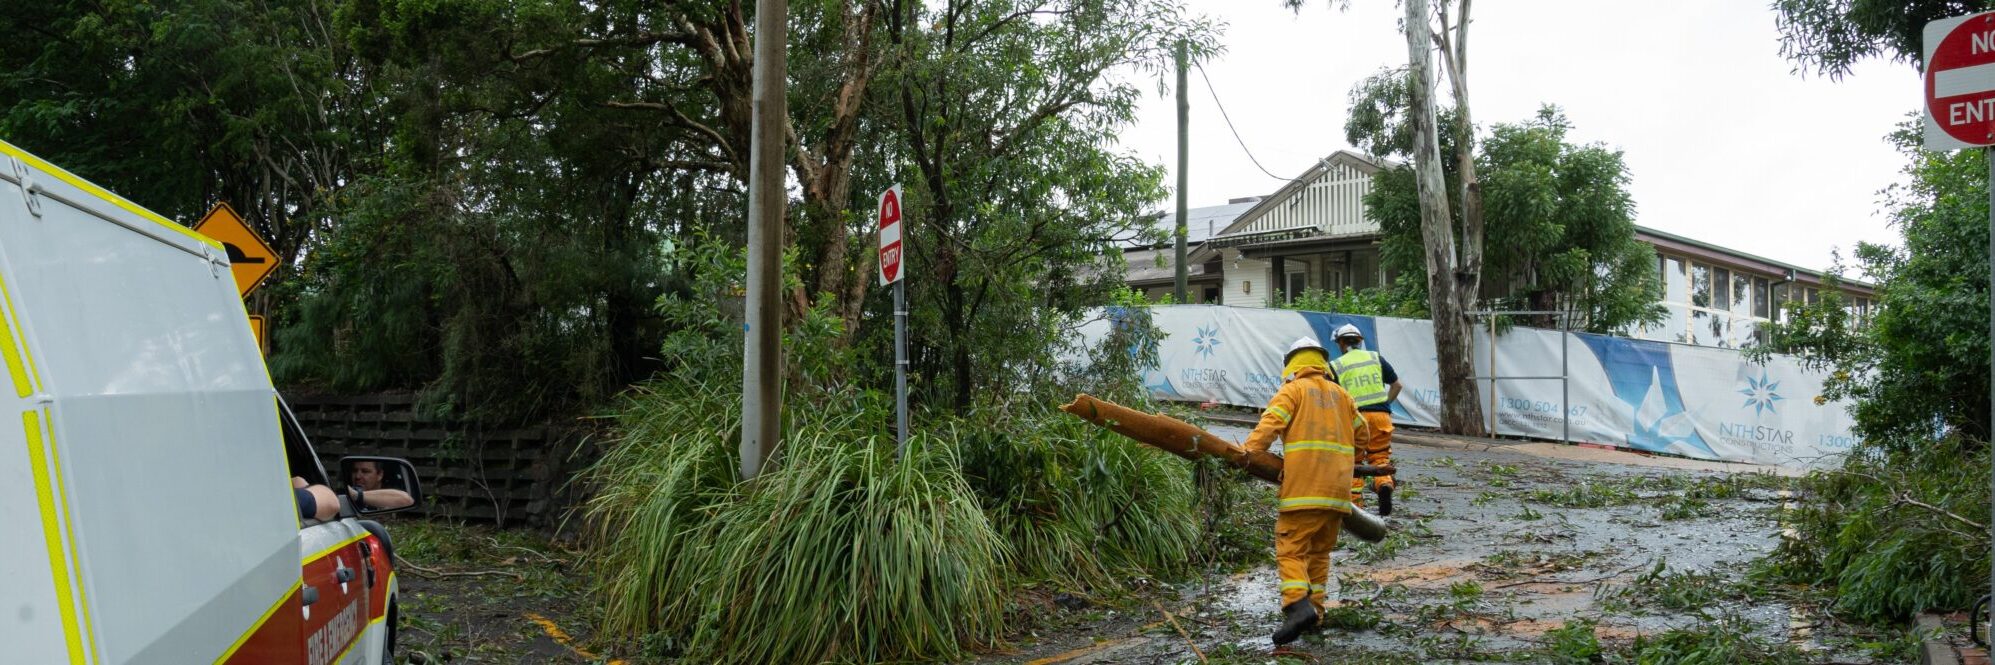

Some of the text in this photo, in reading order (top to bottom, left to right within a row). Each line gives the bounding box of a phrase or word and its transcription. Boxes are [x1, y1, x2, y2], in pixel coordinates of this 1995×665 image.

[886, 201, 893, 219] NO
[882, 245, 900, 269] ENTRY
[1344, 372, 1381, 390] FIRE
[1501, 397, 1588, 417] 1300 504 67
[1499, 411, 1586, 426] www.nthstar.co.au
[1719, 421, 1794, 445] NTHSTAR
[1819, 434, 1852, 449] 1300
[1719, 437, 1795, 454] CONSTRUCTIONS
